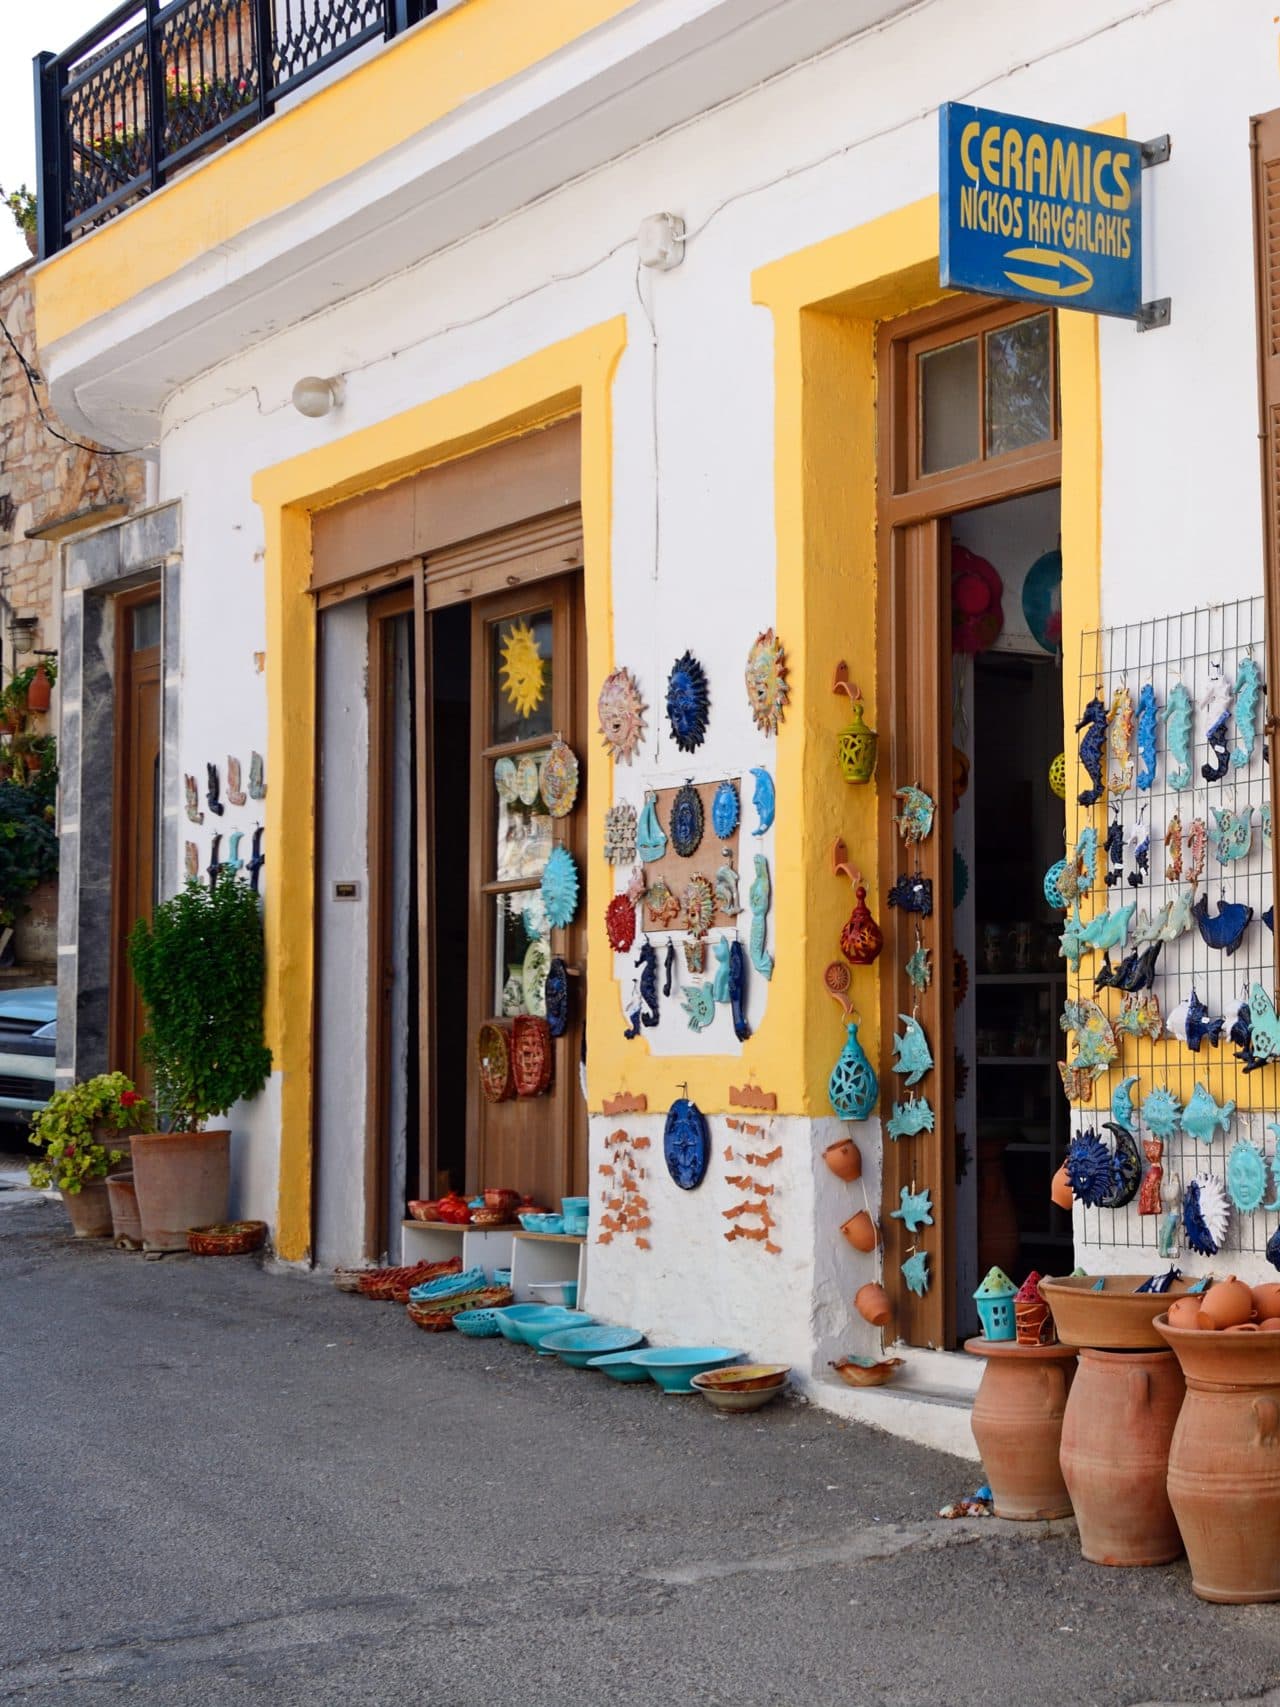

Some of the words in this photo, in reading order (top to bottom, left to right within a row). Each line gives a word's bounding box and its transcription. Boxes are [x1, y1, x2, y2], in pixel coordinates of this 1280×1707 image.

[960, 121, 1132, 211] CERAMICS
[960, 185, 1023, 238] NICKOS
[1028, 199, 1131, 259] KAYGALAKIS
